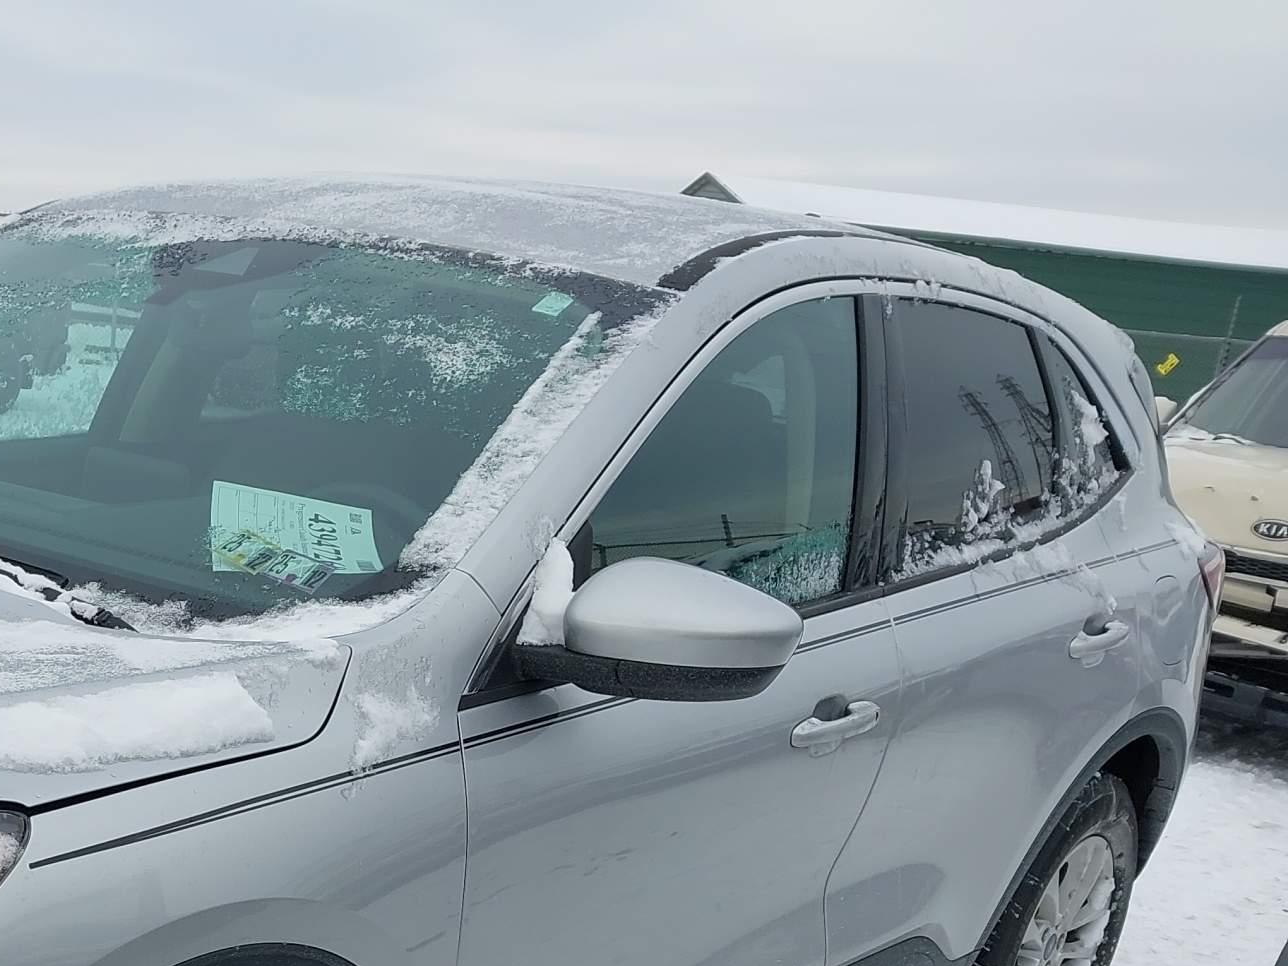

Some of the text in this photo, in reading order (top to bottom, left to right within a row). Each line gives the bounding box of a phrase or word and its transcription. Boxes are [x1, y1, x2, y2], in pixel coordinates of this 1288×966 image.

[1259, 524, 1288, 537] KIA
[221, 534, 251, 552] 25
[268, 554, 328, 588] 25 12
